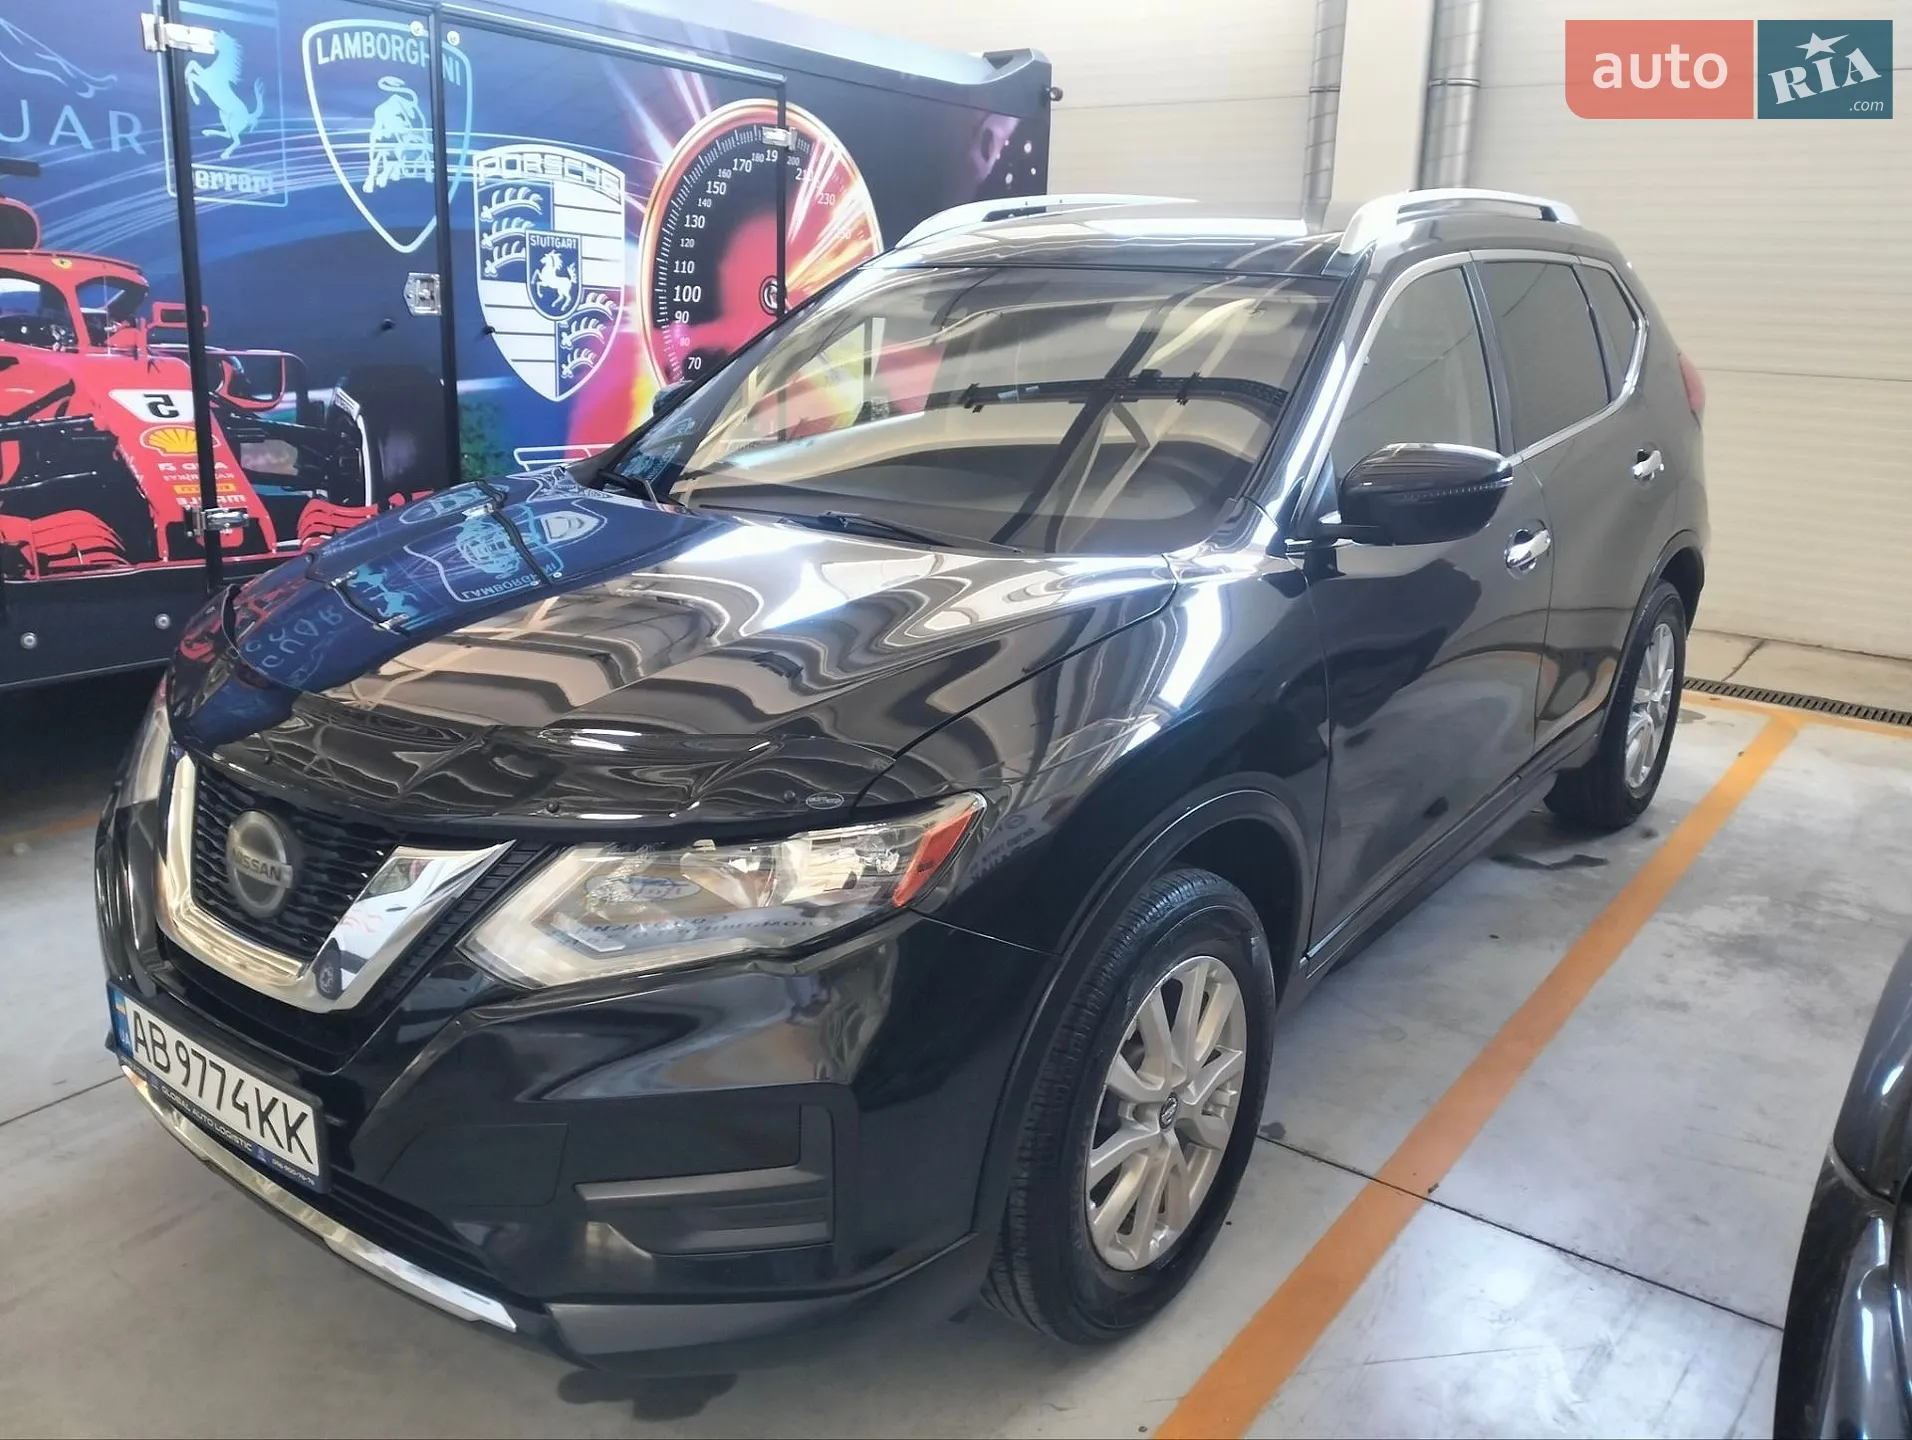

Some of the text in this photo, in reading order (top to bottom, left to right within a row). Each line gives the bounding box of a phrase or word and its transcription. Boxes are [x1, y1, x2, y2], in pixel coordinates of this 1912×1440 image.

[316, 31, 461, 86] LAMBORGHNI
[751, 152, 765, 163] 180
[765, 149, 779, 162] 19
[732, 157, 753, 173] 170
[478, 152, 621, 204] PORSCHE
[717, 168, 732, 179] 160
[193, 169, 276, 195] errari
[706, 180, 727, 195] 150
[697, 197, 712, 208] 140
[817, 193, 836, 205] 230
[684, 214, 706, 229] 130
[529, 234, 578, 249] STUTTGART
[680, 237, 695, 248] 120
[673, 260, 695, 274] 110
[673, 285, 702, 303] 100
[674, 310, 690, 324] 90
[687, 356, 702, 370] 70
[232, 846, 282, 882] NISSAN
[161, 1085, 192, 1112] GLOBAL
[192, 1107, 214, 1126] AUTO
